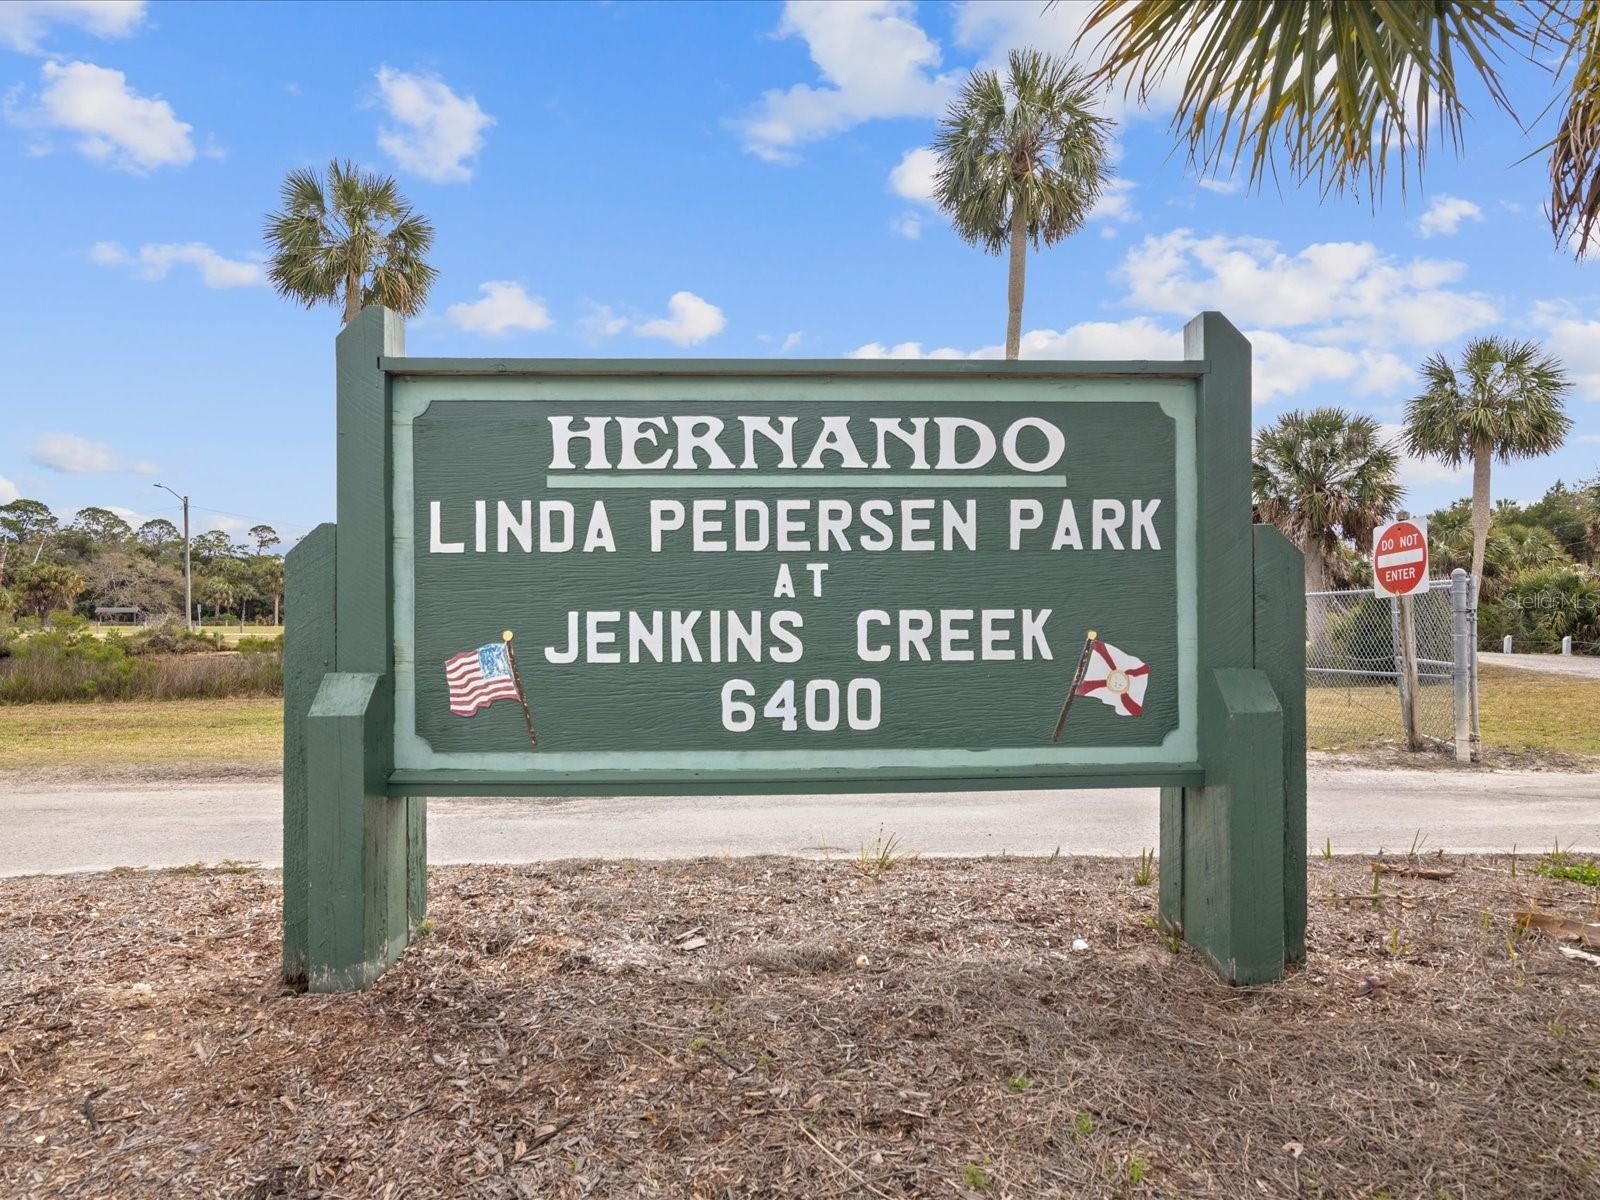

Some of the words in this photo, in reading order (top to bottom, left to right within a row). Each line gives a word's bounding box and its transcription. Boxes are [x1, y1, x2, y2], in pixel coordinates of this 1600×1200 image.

[547, 415, 1066, 472] HERNANDO
[429, 500, 617, 554] LINDA
[650, 499, 977, 553] PEDERSEN
[1009, 498, 1162, 551] PARK
[1381, 538, 1394, 552] DO
[1400, 533, 1419, 548] NOT
[773, 563, 829, 598] AT
[1385, 567, 1416, 582] ENTER
[544, 610, 804, 664] JENKINS
[856, 609, 1054, 662] CREEK
[721, 678, 882, 733] 6400
